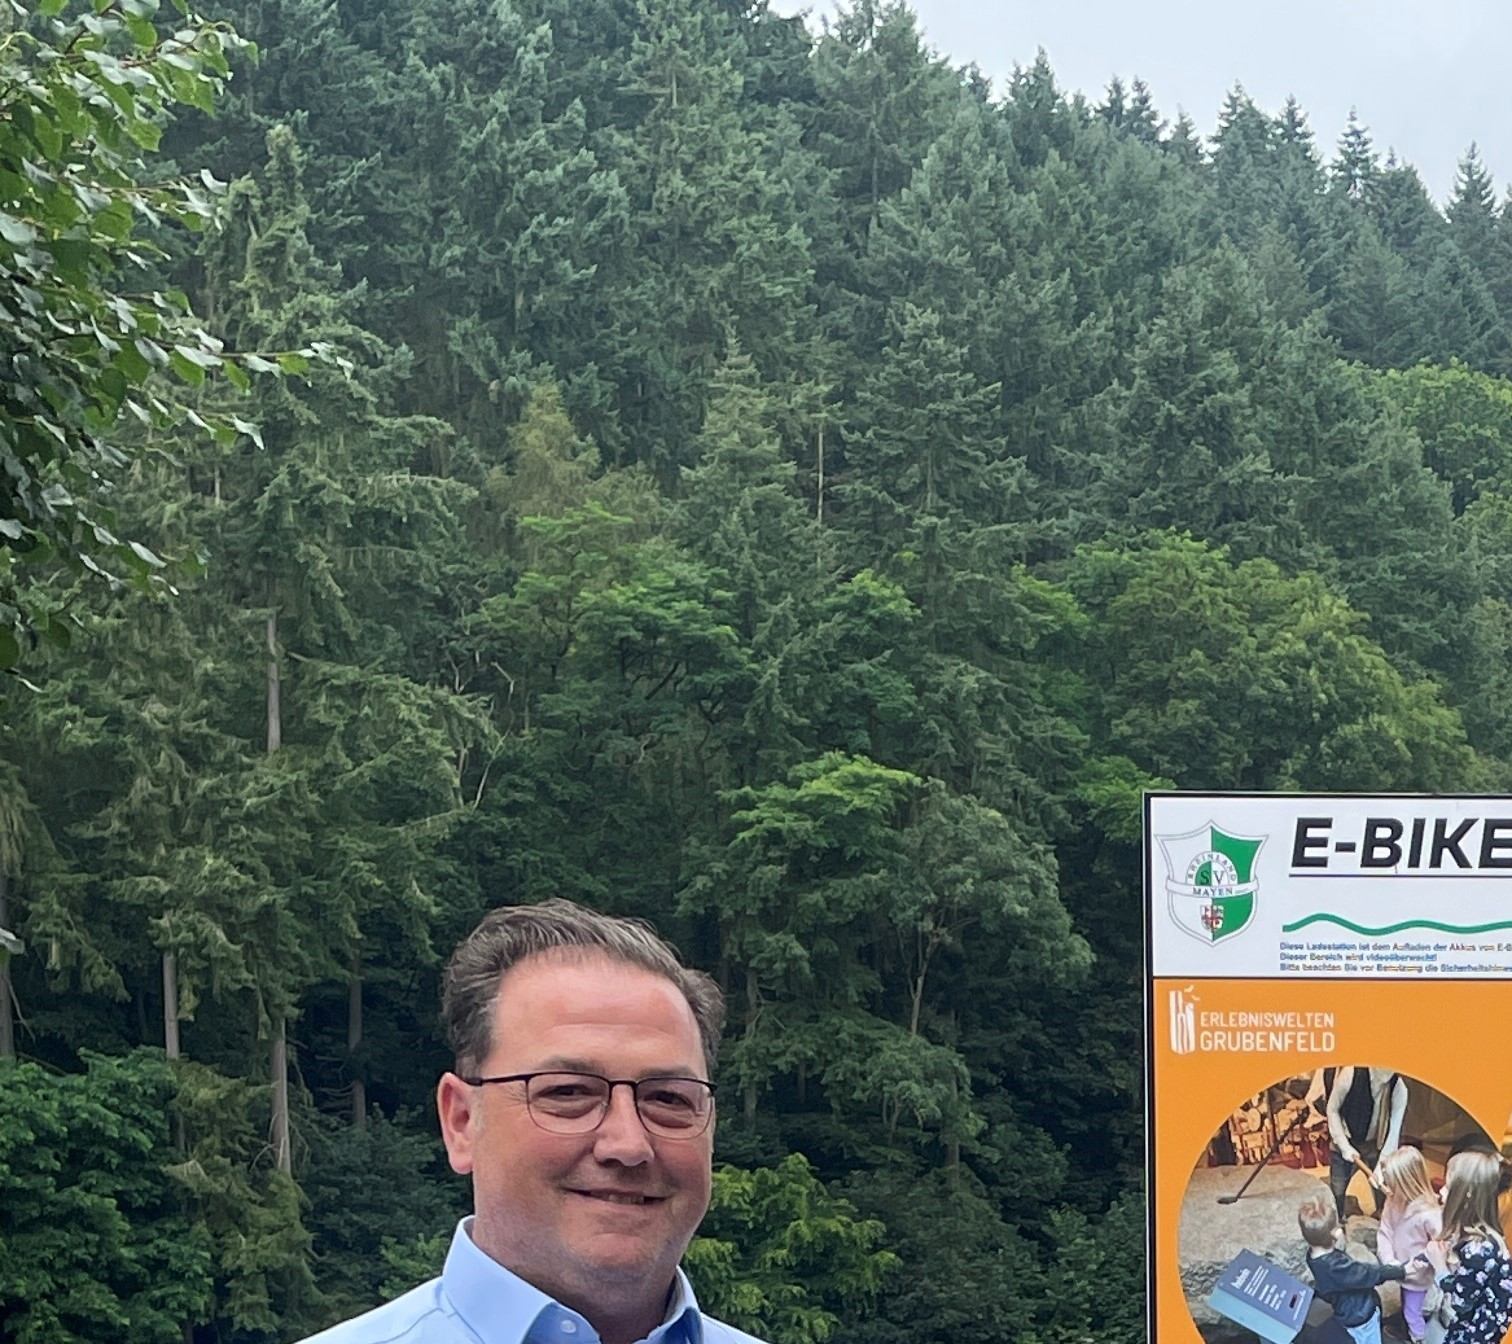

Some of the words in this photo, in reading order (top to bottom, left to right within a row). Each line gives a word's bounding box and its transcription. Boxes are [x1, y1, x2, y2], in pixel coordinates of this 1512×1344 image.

[1193, 887, 1233, 896] MAYEN
[1200, 1011, 1335, 1029] ERLEBNISWELTEN
[1200, 1030, 1336, 1053] GRUBENFELD
